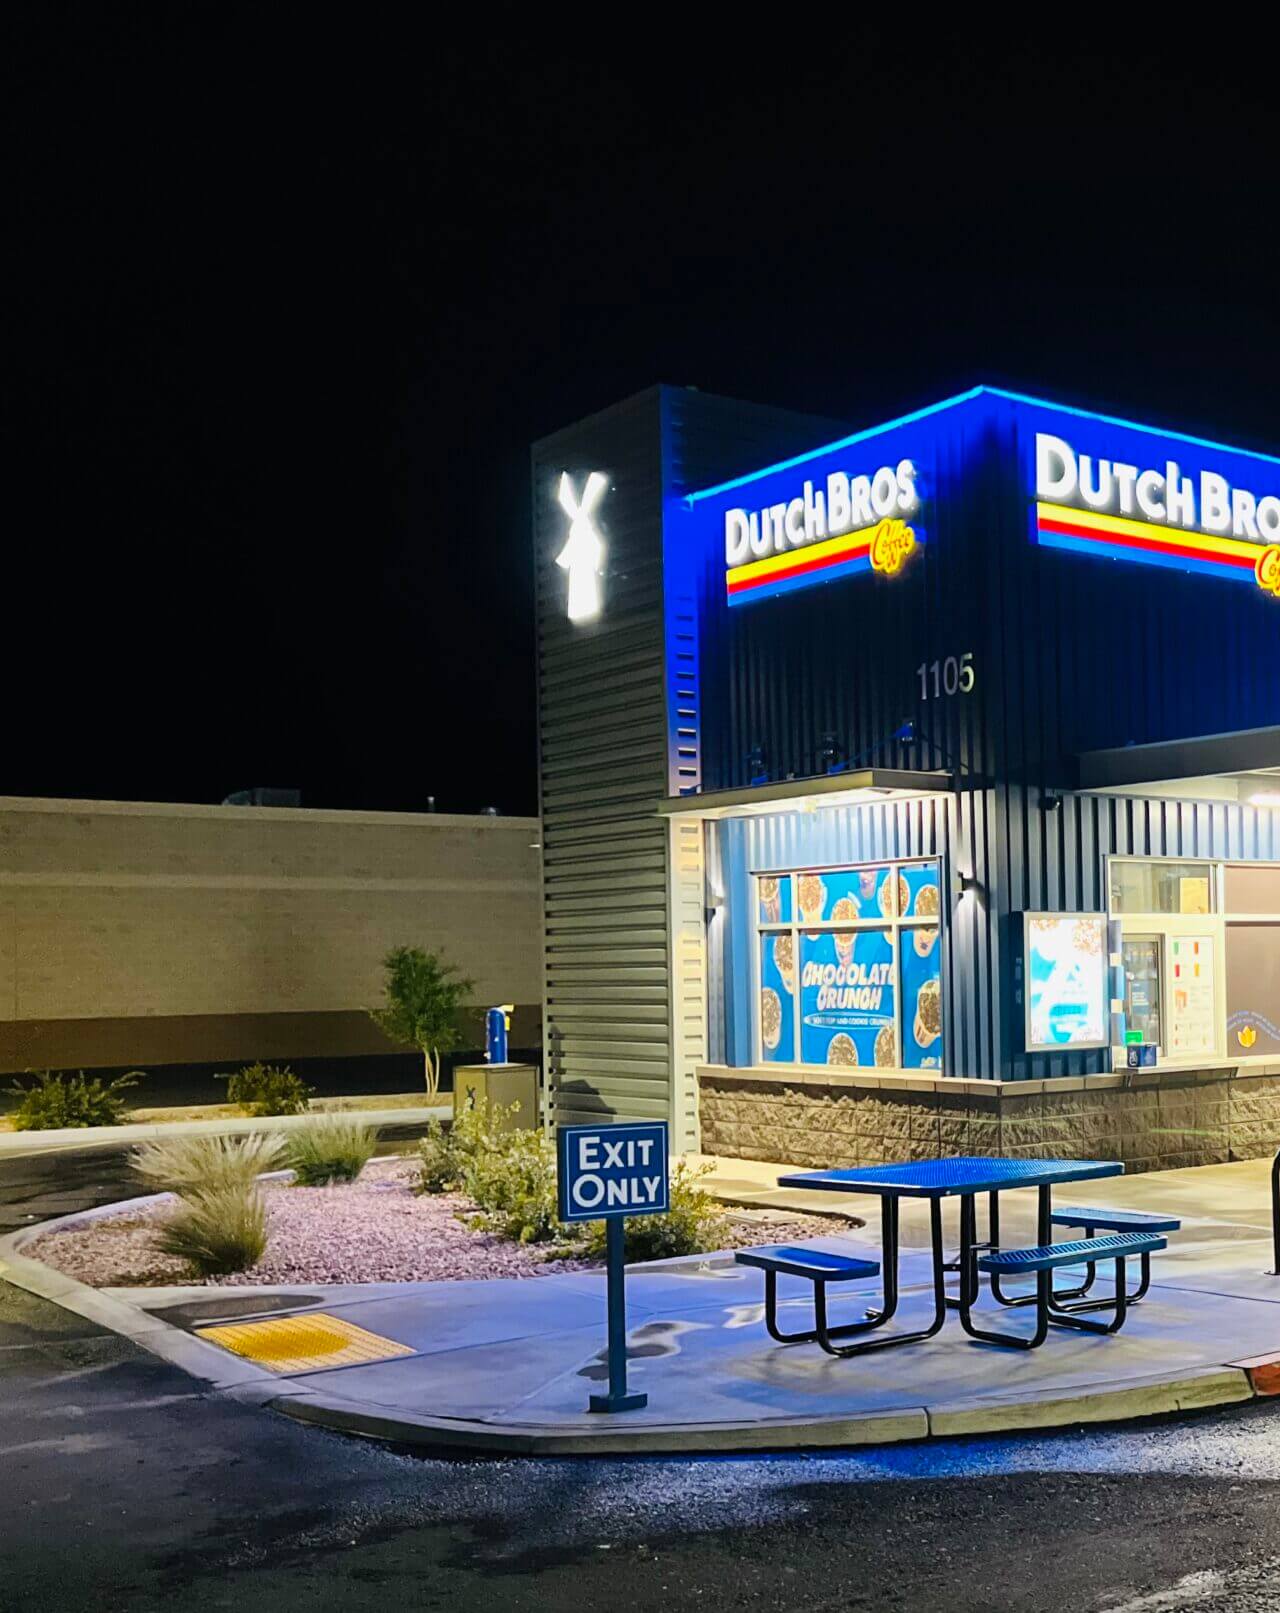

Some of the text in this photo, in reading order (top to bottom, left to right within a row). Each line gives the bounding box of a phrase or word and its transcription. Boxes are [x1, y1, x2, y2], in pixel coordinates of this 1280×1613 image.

[827, 459, 917, 531] BROS
[872, 523, 912, 567] Coffee
[916, 652, 974, 700] 1105
[817, 985, 882, 1011] CRUNCH
[579, 1136, 654, 1170] EXIT
[572, 1174, 661, 1208] ONLY
